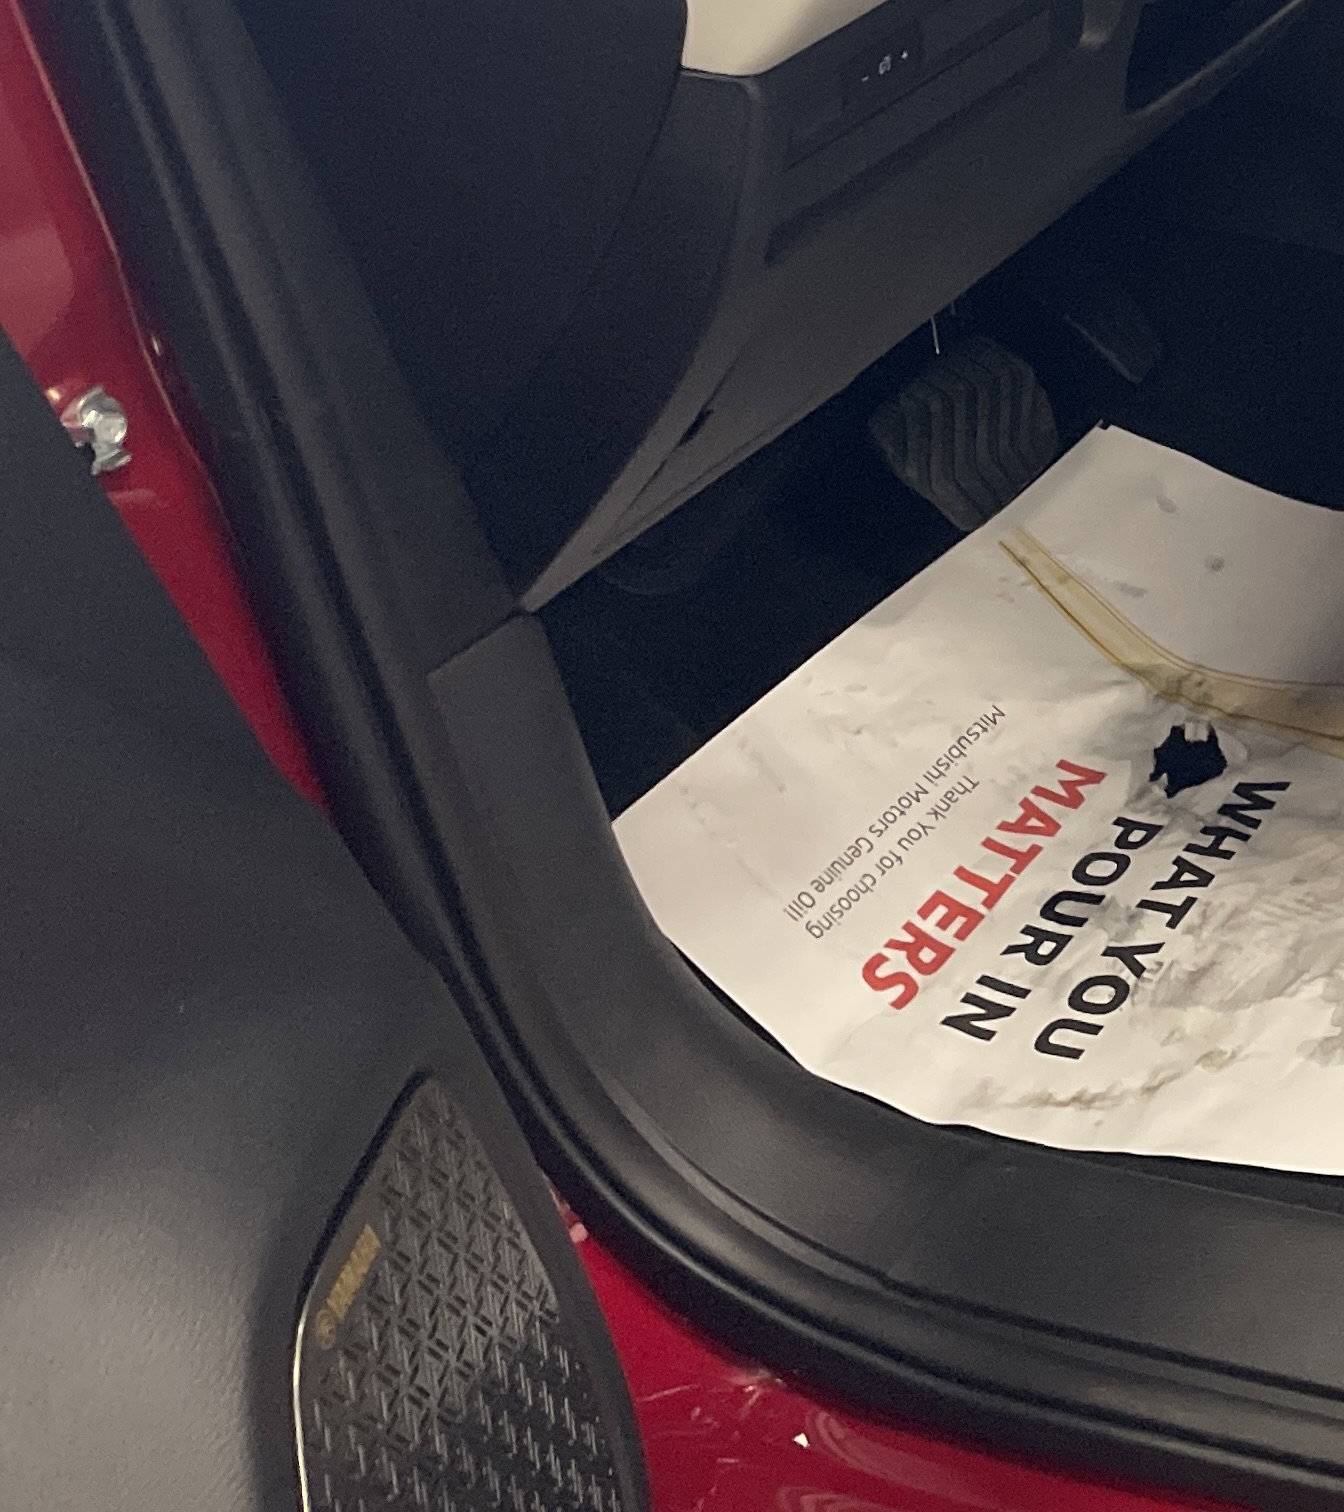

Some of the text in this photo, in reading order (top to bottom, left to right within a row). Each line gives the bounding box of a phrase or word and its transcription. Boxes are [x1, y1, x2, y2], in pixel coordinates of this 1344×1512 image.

[783, 705, 1006, 922] Mitsubishi Motors Genuine Oil!
[805, 775, 980, 939] Thank You for choosing
[861, 759, 1107, 1011] MATTERS
[1034, 781, 1292, 1061] WHAT YOU
[940, 816, 1164, 1042] POUR IN
